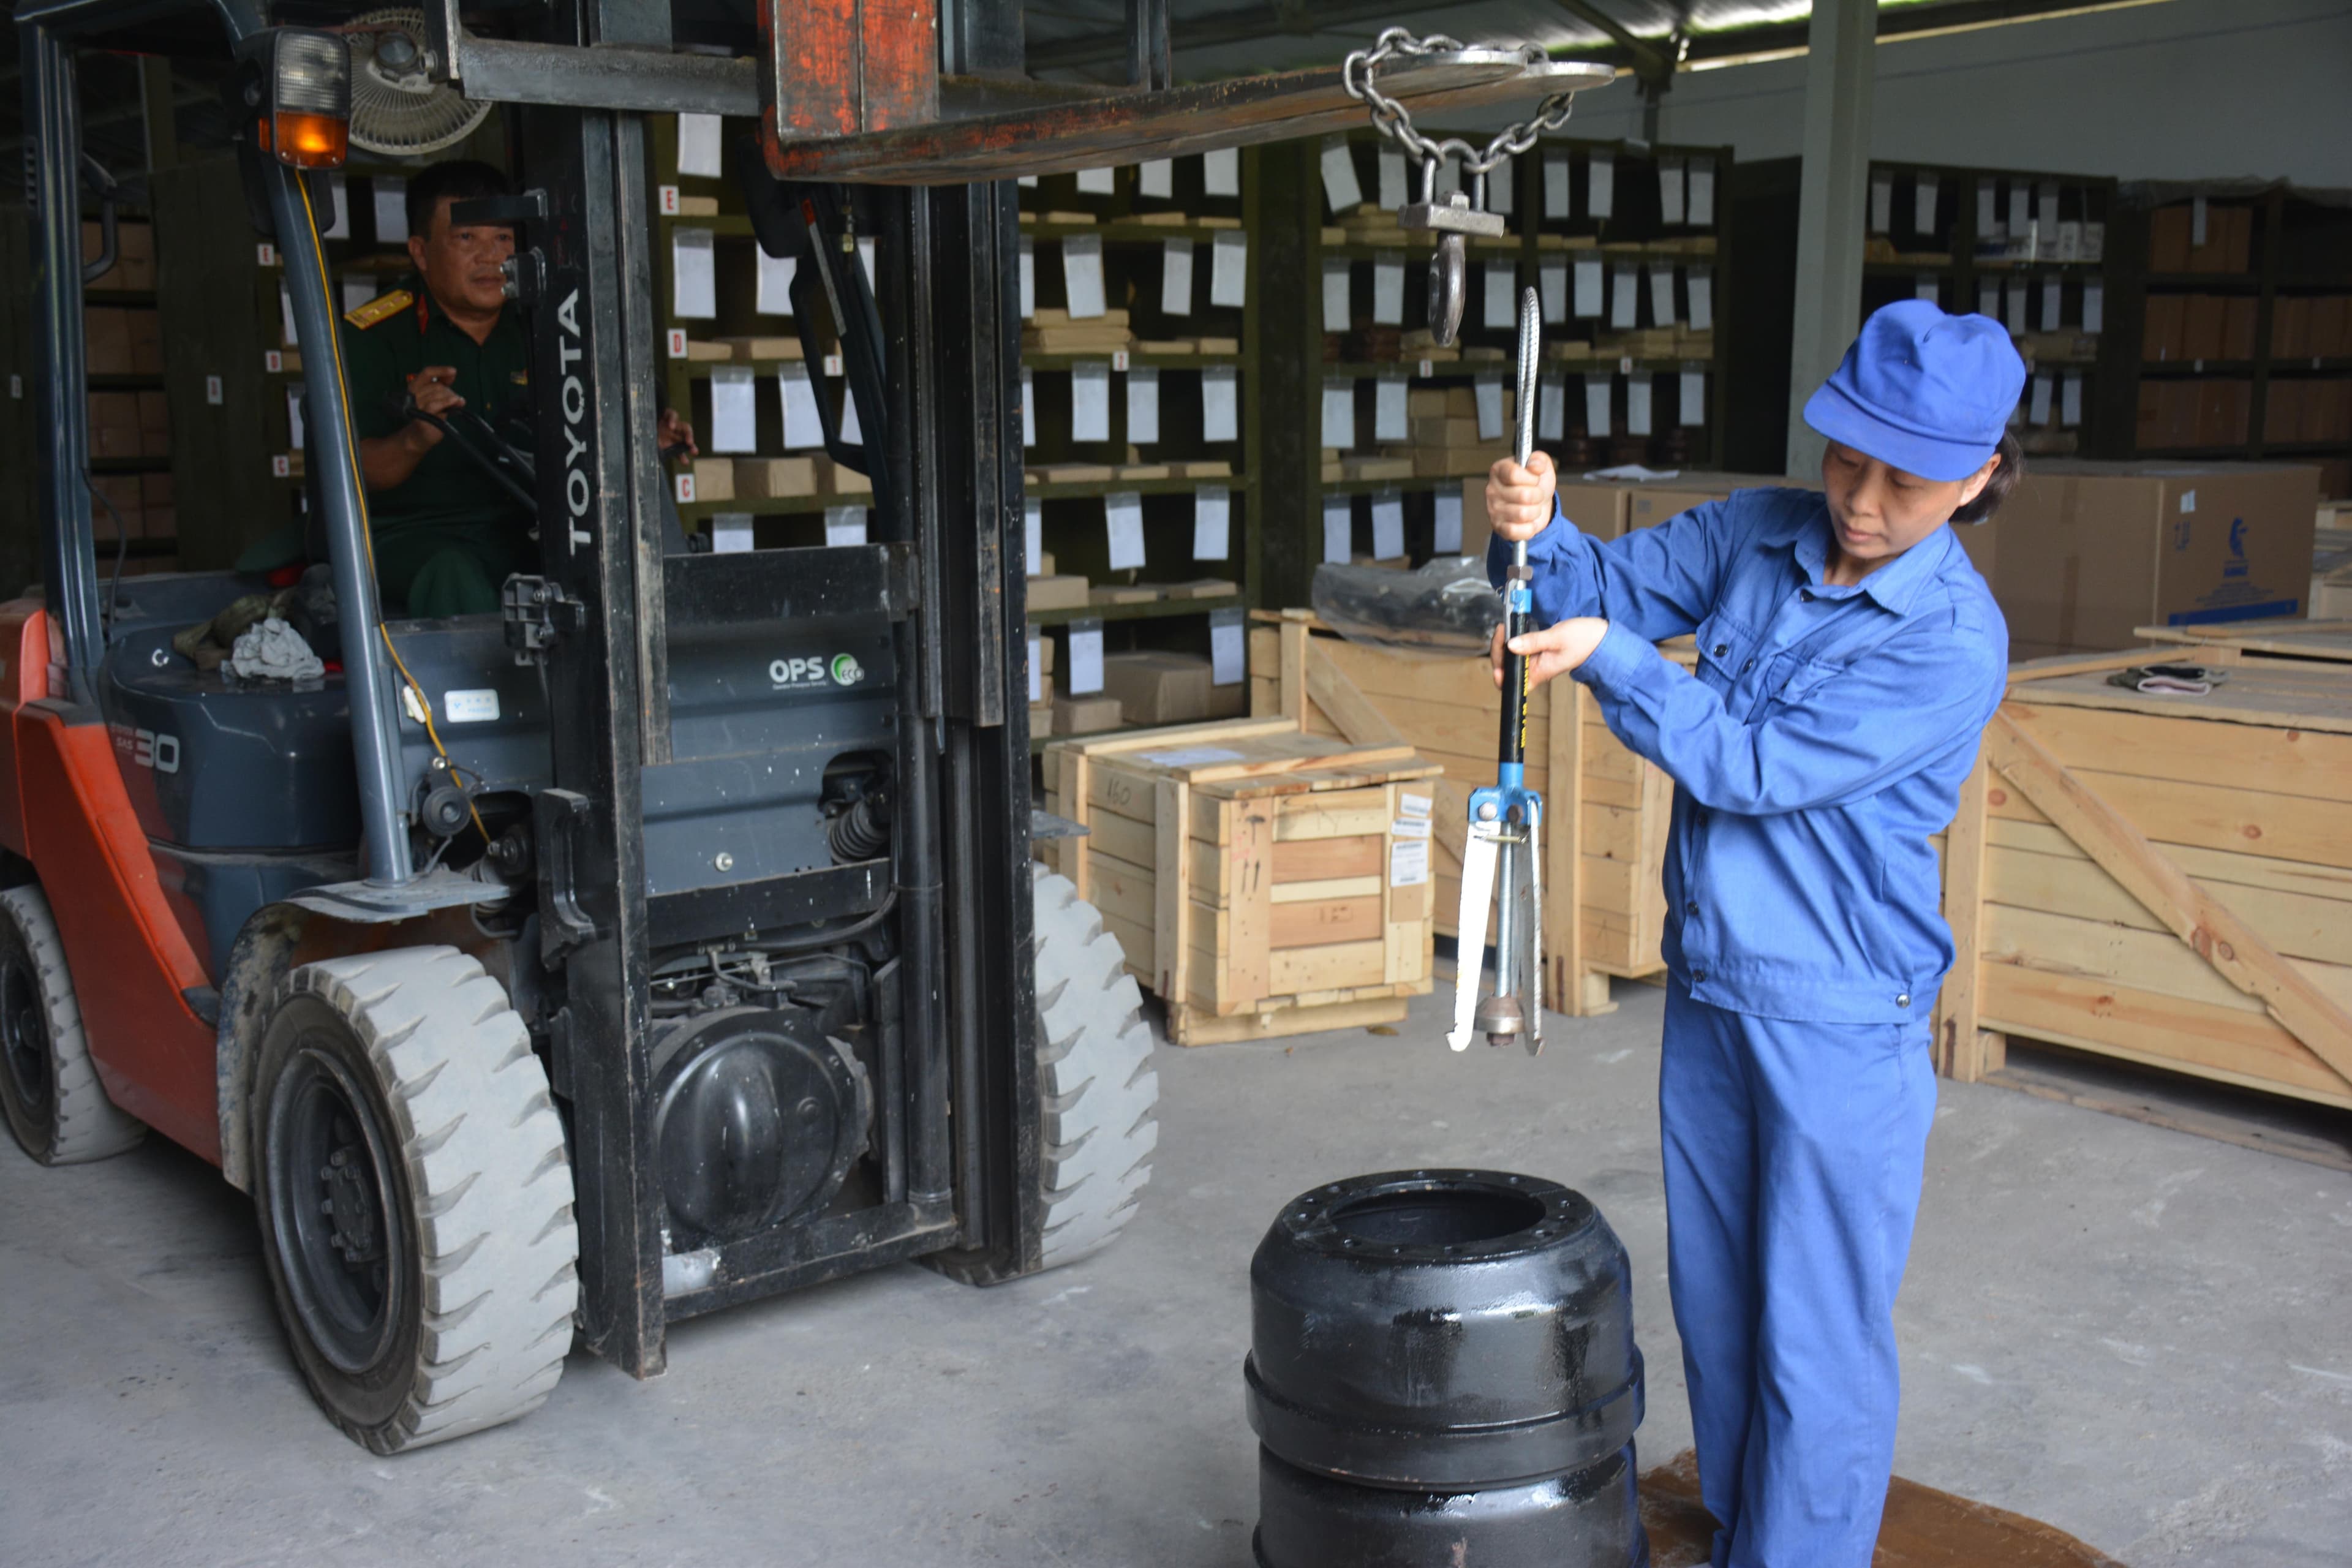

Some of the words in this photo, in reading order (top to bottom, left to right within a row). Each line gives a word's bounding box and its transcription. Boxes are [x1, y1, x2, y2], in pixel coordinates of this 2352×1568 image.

[667, 190, 674, 209] E
[674, 333, 681, 353] D
[557, 288, 592, 557] TOYOTA
[682, 478, 690, 497] C
[769, 657, 825, 683] OPS
[842, 666, 864, 681] ECO
[135, 728, 180, 774] 30
[1107, 778, 1133, 806] 160
